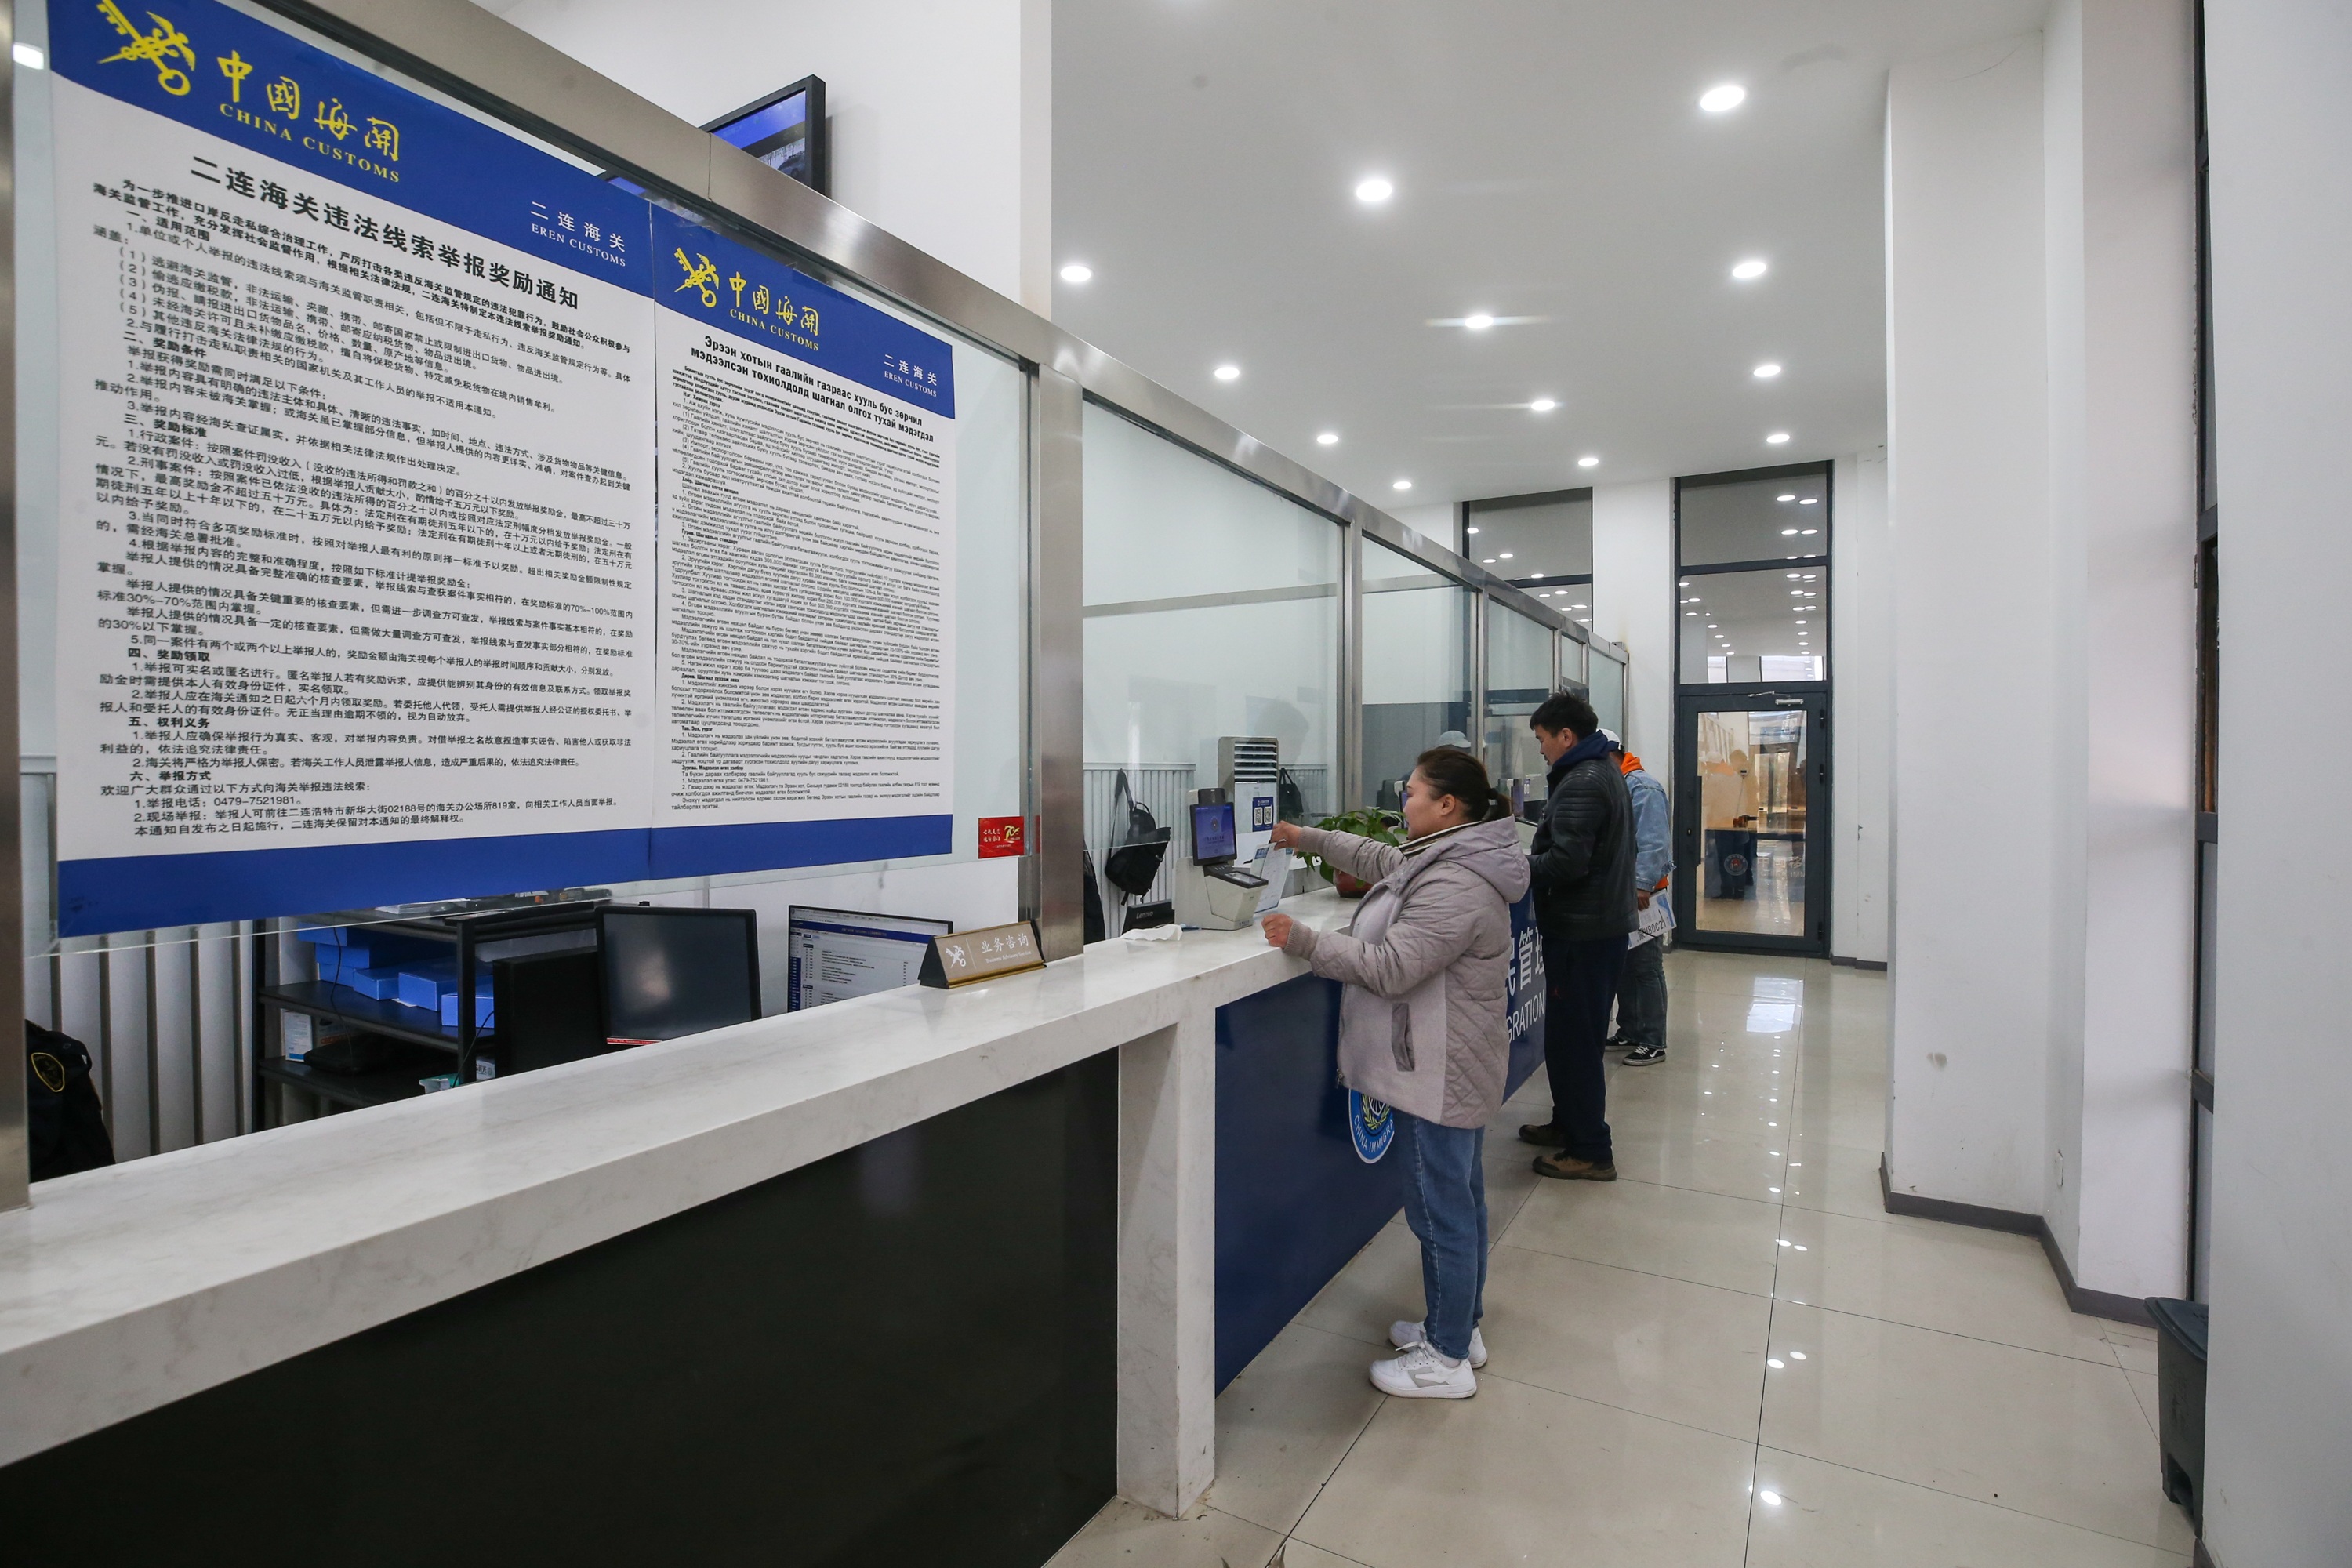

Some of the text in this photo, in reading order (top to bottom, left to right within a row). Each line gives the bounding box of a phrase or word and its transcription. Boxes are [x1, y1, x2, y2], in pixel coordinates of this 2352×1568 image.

[220, 103, 400, 183] CHINA CUSTOMS
[191, 153, 578, 311] 二连海关违法线索举报奖励通知
[531, 201, 626, 252] 二连海关
[532, 223, 626, 267] EREN CUSTOMS
[730, 309, 818, 351] CHINA CUSTOMS
[705, 336, 922, 426] Эрээн хотын гаалийн газраас хууль бус зөрчил
[884, 354, 937, 386] 二连海关
[884, 371, 937, 397] EREN CUSTOMS
[691, 348, 934, 442] мэдээлсэн тохиолдолд шагнал олгох тухай мэдэгдэл
[982, 933, 1029, 953] 业务咨询
[1355, 1115, 1367, 1150] CHINA
